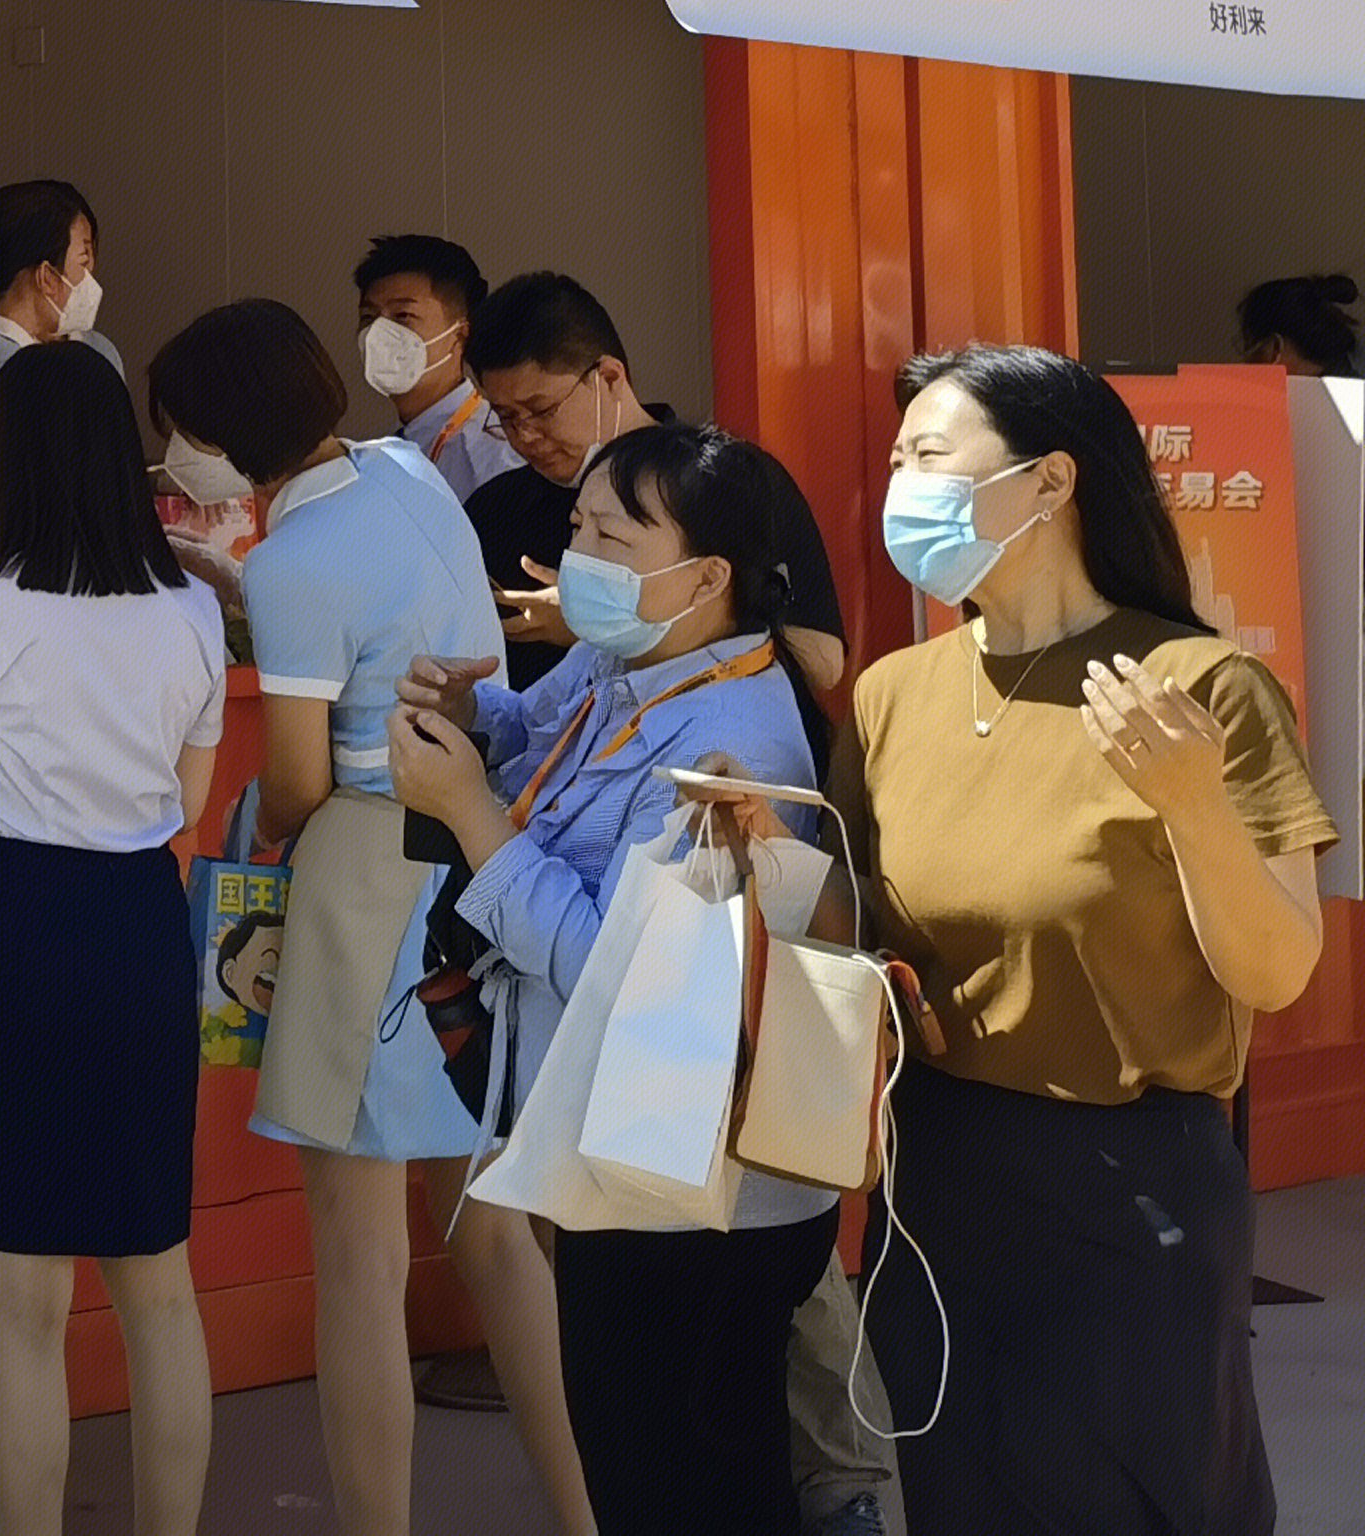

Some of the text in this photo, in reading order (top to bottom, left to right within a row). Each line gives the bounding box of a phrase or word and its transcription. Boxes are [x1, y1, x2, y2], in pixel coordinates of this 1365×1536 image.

[1209, 2, 1267, 36] 好利来
[1137, 425, 1193, 462] 际
